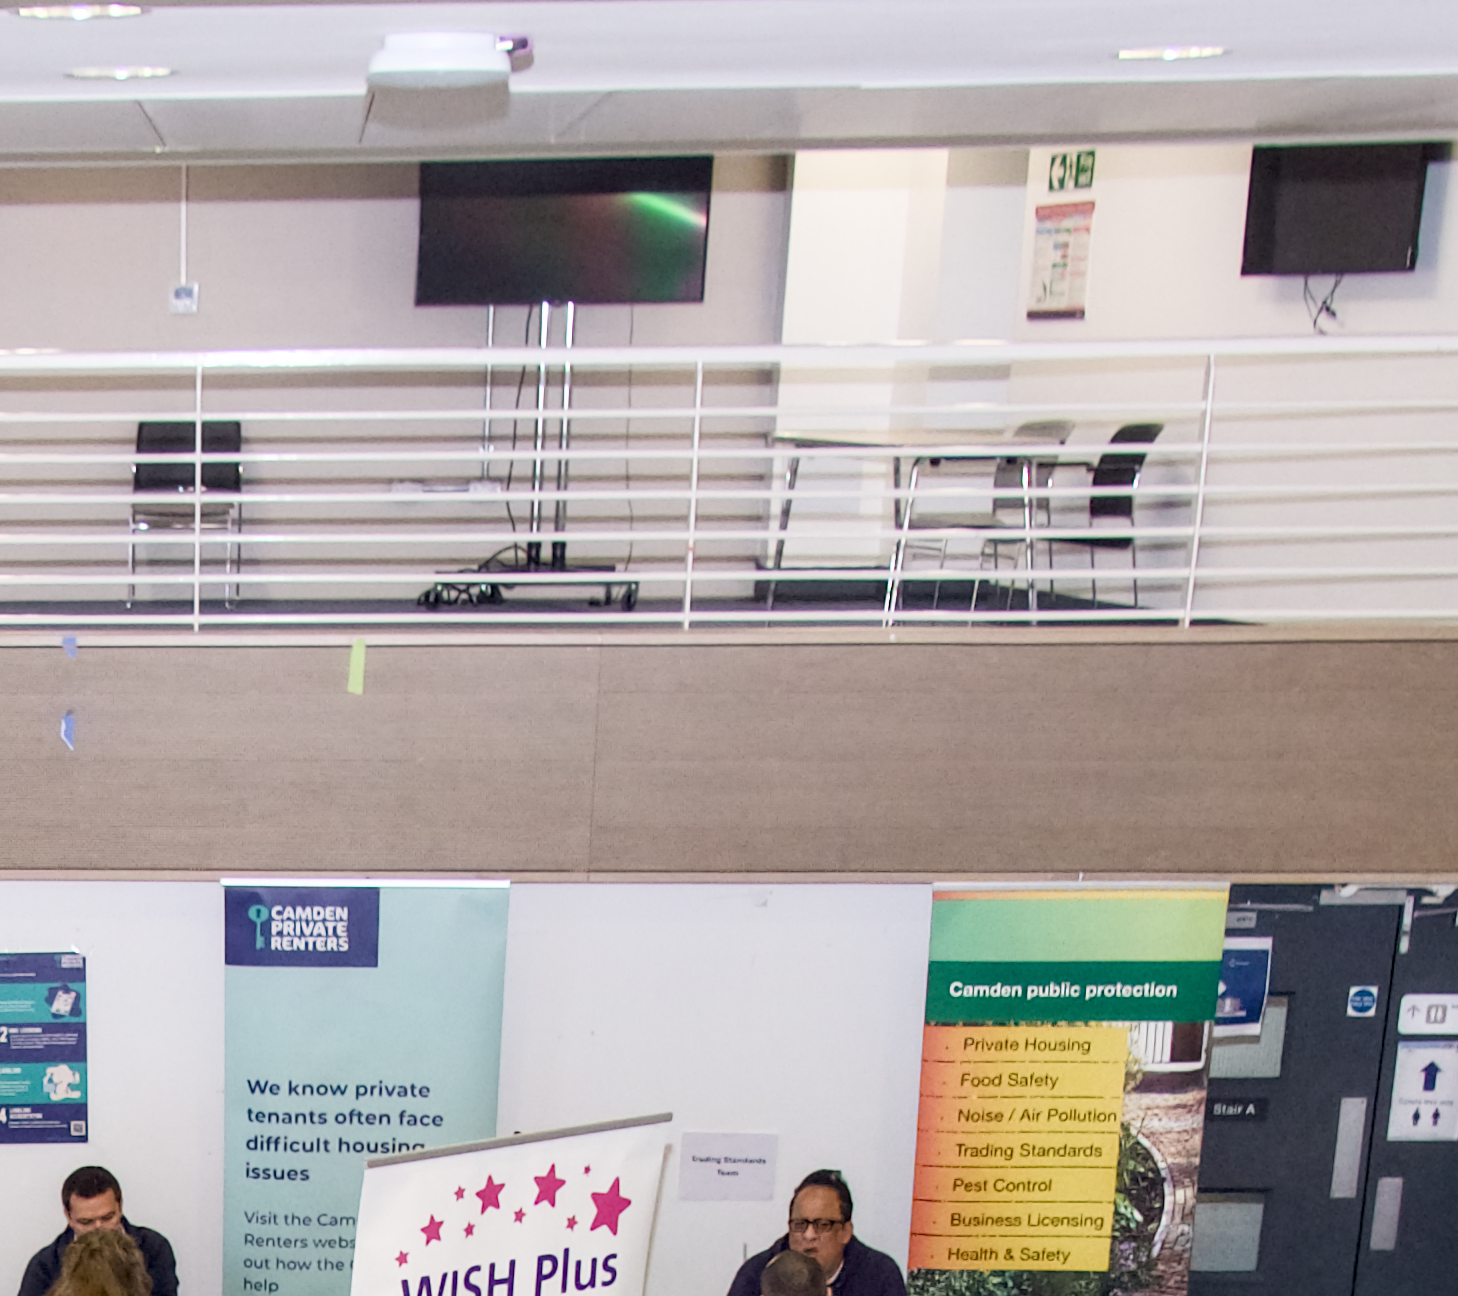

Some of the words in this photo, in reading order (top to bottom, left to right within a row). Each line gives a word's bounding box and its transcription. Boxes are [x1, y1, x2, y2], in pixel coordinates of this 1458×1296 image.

[271, 905, 348, 921] CAMDEN
[271, 920, 348, 937] PRIVATE
[270, 936, 349, 952] RENTERS
[949, 981, 1022, 998] Camden
[1026, 981, 1080, 1000] public
[1085, 981, 1178, 1001] protection
[0, 1026, 8, 1043] 2
[963, 1037, 1019, 1052] Private
[1024, 1038, 1091, 1055] Housing
[247, 1079, 280, 1096] We
[288, 1080, 348, 1096] know
[355, 1080, 430, 1100] private
[960, 1073, 1002, 1087] Food
[1007, 1073, 1059, 1090] Safety
[247, 1108, 327, 1125] tenants
[334, 1109, 390, 1126] often
[399, 1110, 443, 1127] face
[957, 1108, 1004, 1123] Noise
[1019, 1108, 1042, 1123] Air
[1047, 1108, 1117, 1123] Pollution
[1245, 1103, 1255, 1116] A
[246, 1135, 330, 1153] difficult
[955, 1143, 1014, 1161] Trading
[1019, 1143, 1103, 1158] Standards
[246, 1162, 310, 1181] issues
[952, 1178, 988, 1193] Pest
[993, 1178, 1053, 1193] Control
[244, 1211, 279, 1226] Visit
[284, 1212, 312, 1226] the
[317, 1213, 356, 1227] Cam
[950, 1212, 1022, 1227] Business
[1027, 1213, 1104, 1231] Licensing
[244, 1233, 308, 1249] Renters
[313, 1236, 356, 1249] webs
[244, 1258, 270, 1270] out
[276, 1257, 311, 1271] how
[317, 1257, 344, 1271] the
[947, 1247, 998, 1262] Health
[1003, 1248, 1014, 1262] &
[1019, 1247, 1071, 1265] Safety
[243, 1277, 279, 1294] help
